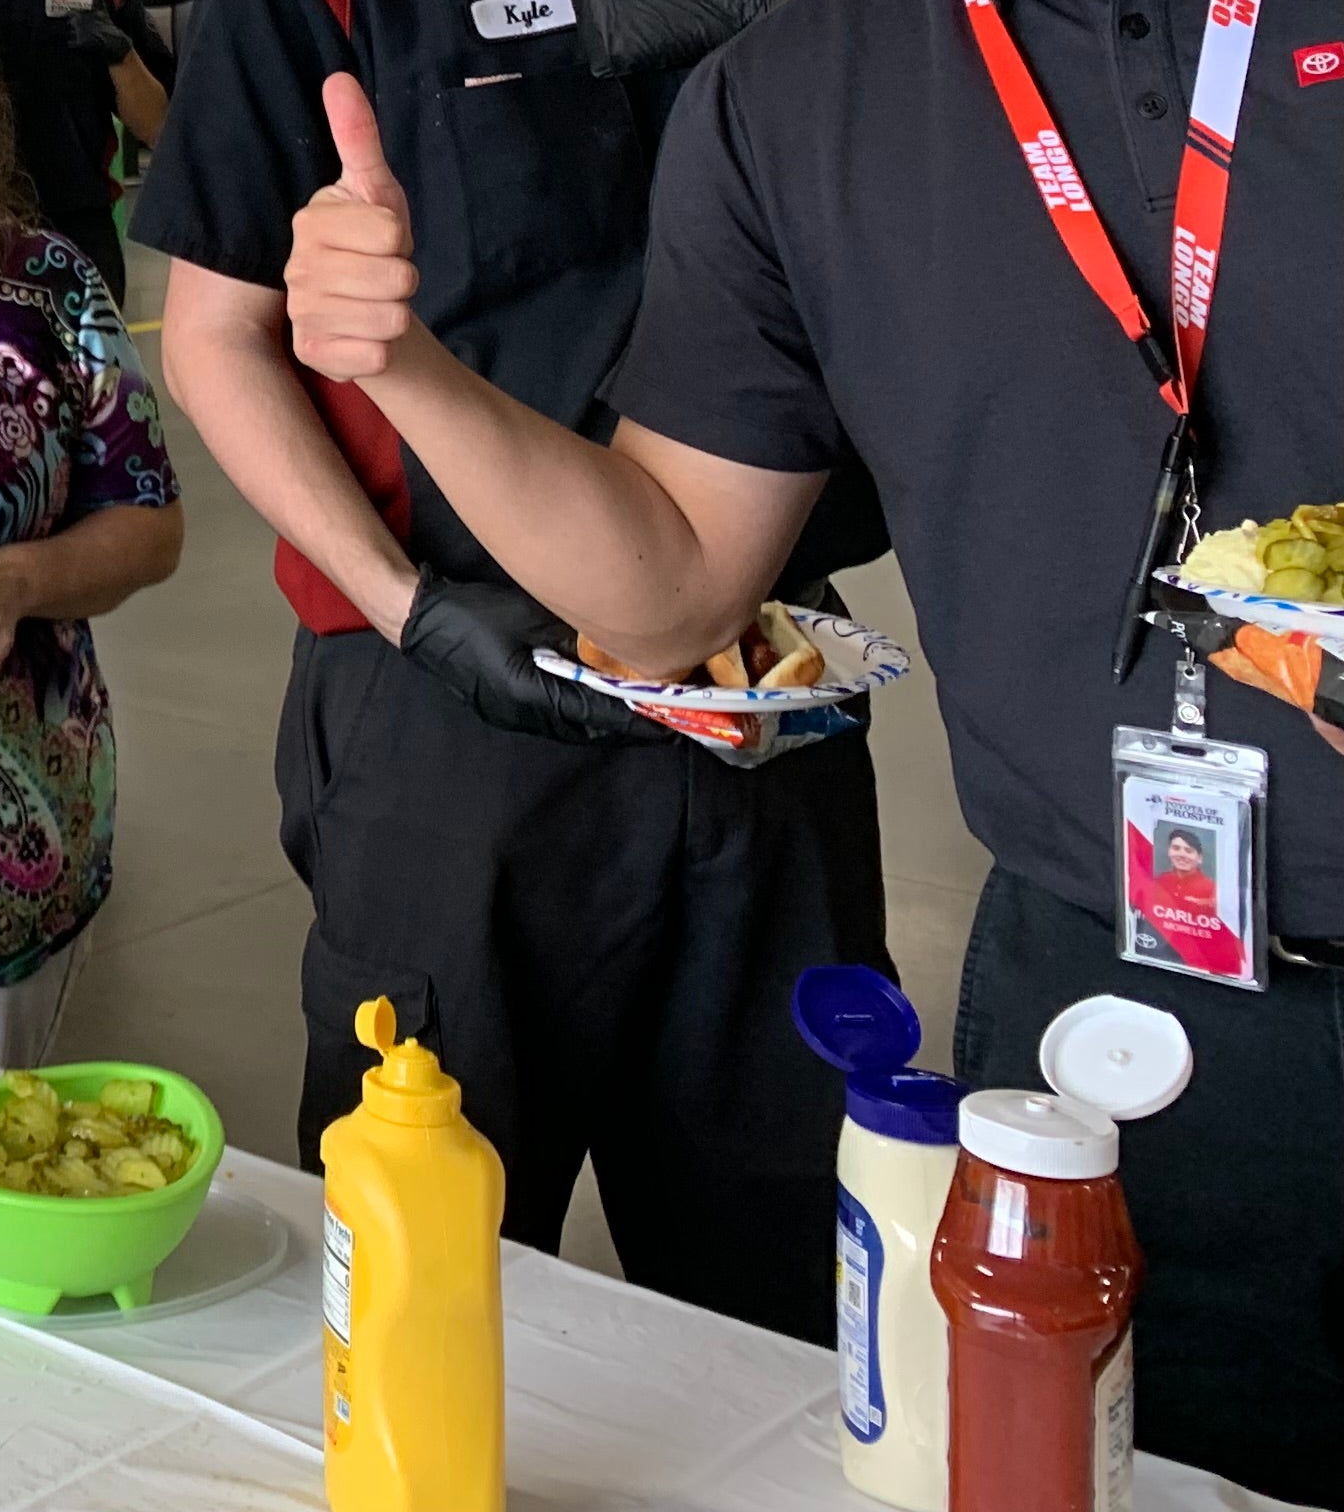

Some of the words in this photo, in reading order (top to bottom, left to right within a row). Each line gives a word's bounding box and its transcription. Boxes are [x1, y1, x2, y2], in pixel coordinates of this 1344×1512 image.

[505, 1, 554, 28] Kyle
[1021, 141, 1068, 210] TEAM
[1037, 129, 1092, 212] LONGO
[1174, 225, 1196, 329] LONGO
[1190, 245, 1216, 330] TEAM
[1165, 808, 1225, 826] PROSPER
[1153, 904, 1222, 931] CARLOS
